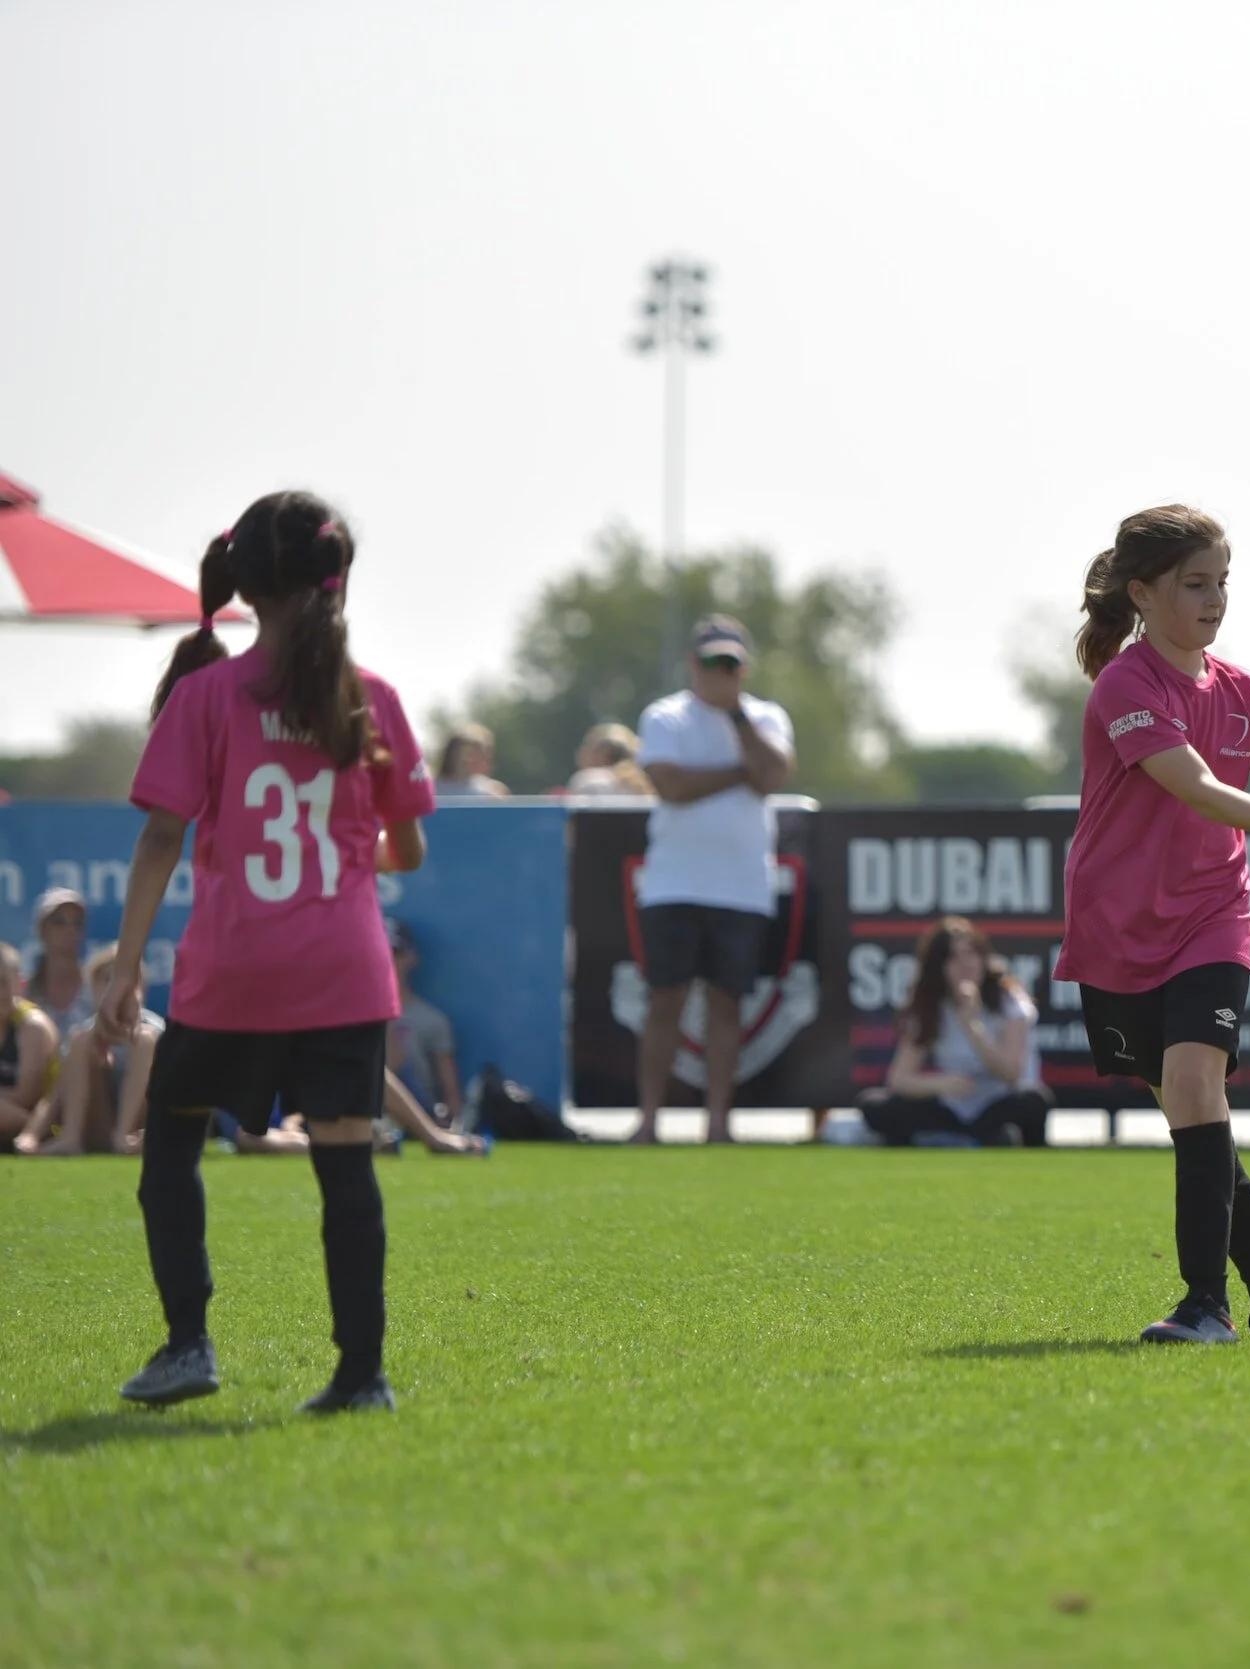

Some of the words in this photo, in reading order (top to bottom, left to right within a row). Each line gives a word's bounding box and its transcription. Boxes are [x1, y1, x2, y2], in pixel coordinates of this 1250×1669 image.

[1110, 713, 1135, 730] STRIVE
[1134, 710, 1150, 719] TO
[244, 763, 340, 902] 31
[848, 836, 1052, 915] DUBAI
